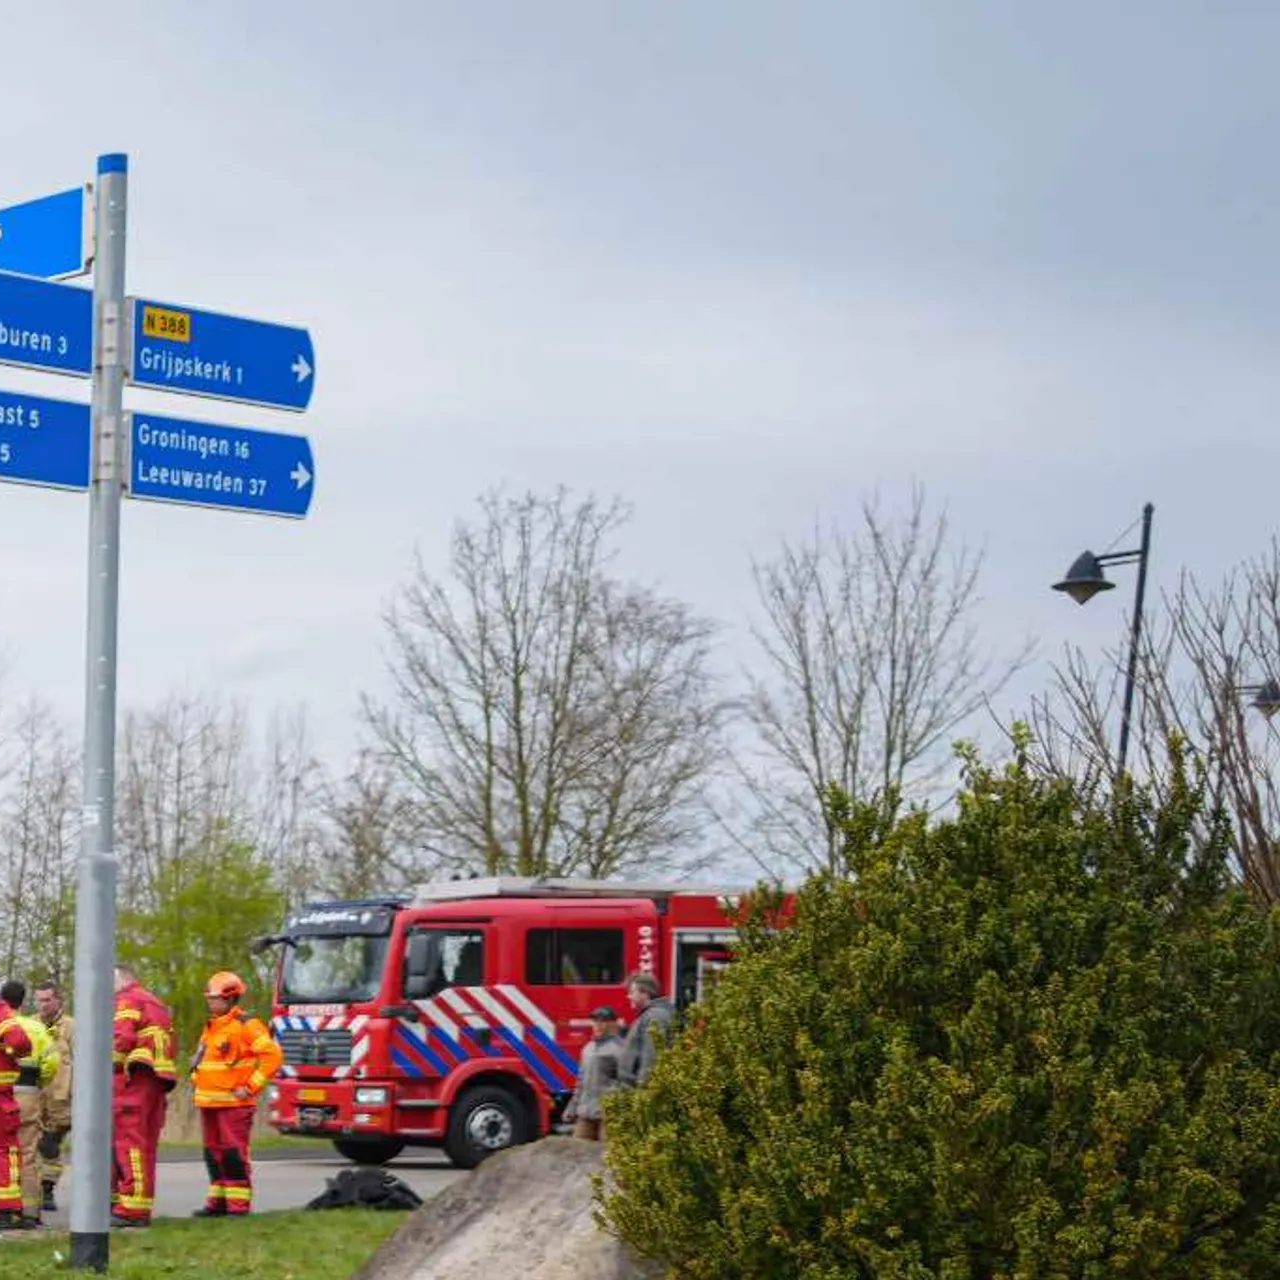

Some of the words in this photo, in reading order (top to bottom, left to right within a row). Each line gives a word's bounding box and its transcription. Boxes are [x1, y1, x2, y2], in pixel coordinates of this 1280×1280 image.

[145, 314, 156, 331] N
[159, 315, 187, 336] 388
[58, 336, 68, 354] 3
[140, 347, 232, 384] Grijpskerk
[237, 367, 244, 385] 1
[29, 409, 40, 429] 5
[138, 423, 230, 459] Groningen
[234, 440, 251, 460] 16
[0, 443, 11, 463] 5
[138, 460, 244, 493] Leeuwarden
[249, 479, 268, 496] 37
